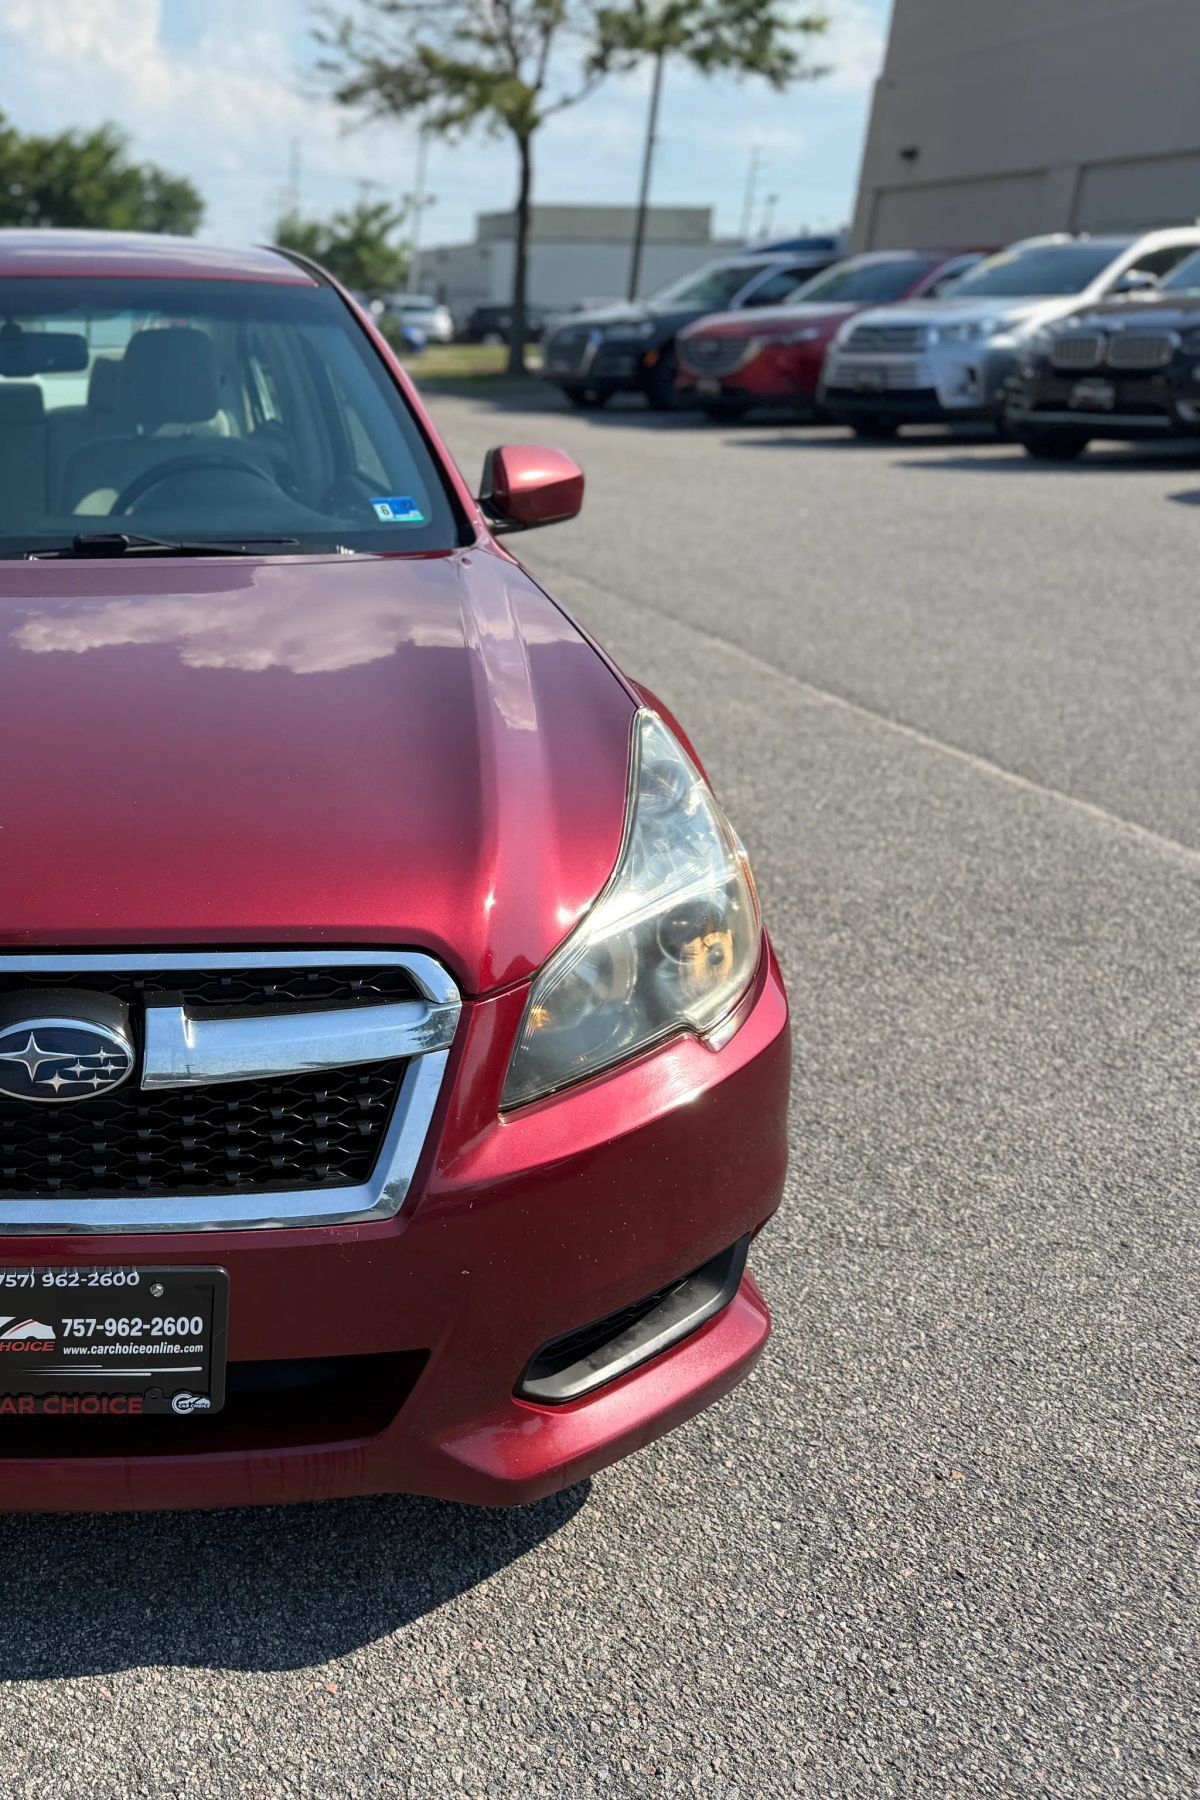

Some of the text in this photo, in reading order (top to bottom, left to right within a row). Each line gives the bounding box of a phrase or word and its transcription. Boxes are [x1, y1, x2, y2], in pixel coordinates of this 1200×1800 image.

[380, 505, 390, 516] 6
[42, 1270, 140, 1287] 962-2600
[61, 1316, 204, 1337] 757-962-2600
[63, 1341, 204, 1355] www.carchoiceonline.com
[43, 1396, 144, 1415] CHOICE
